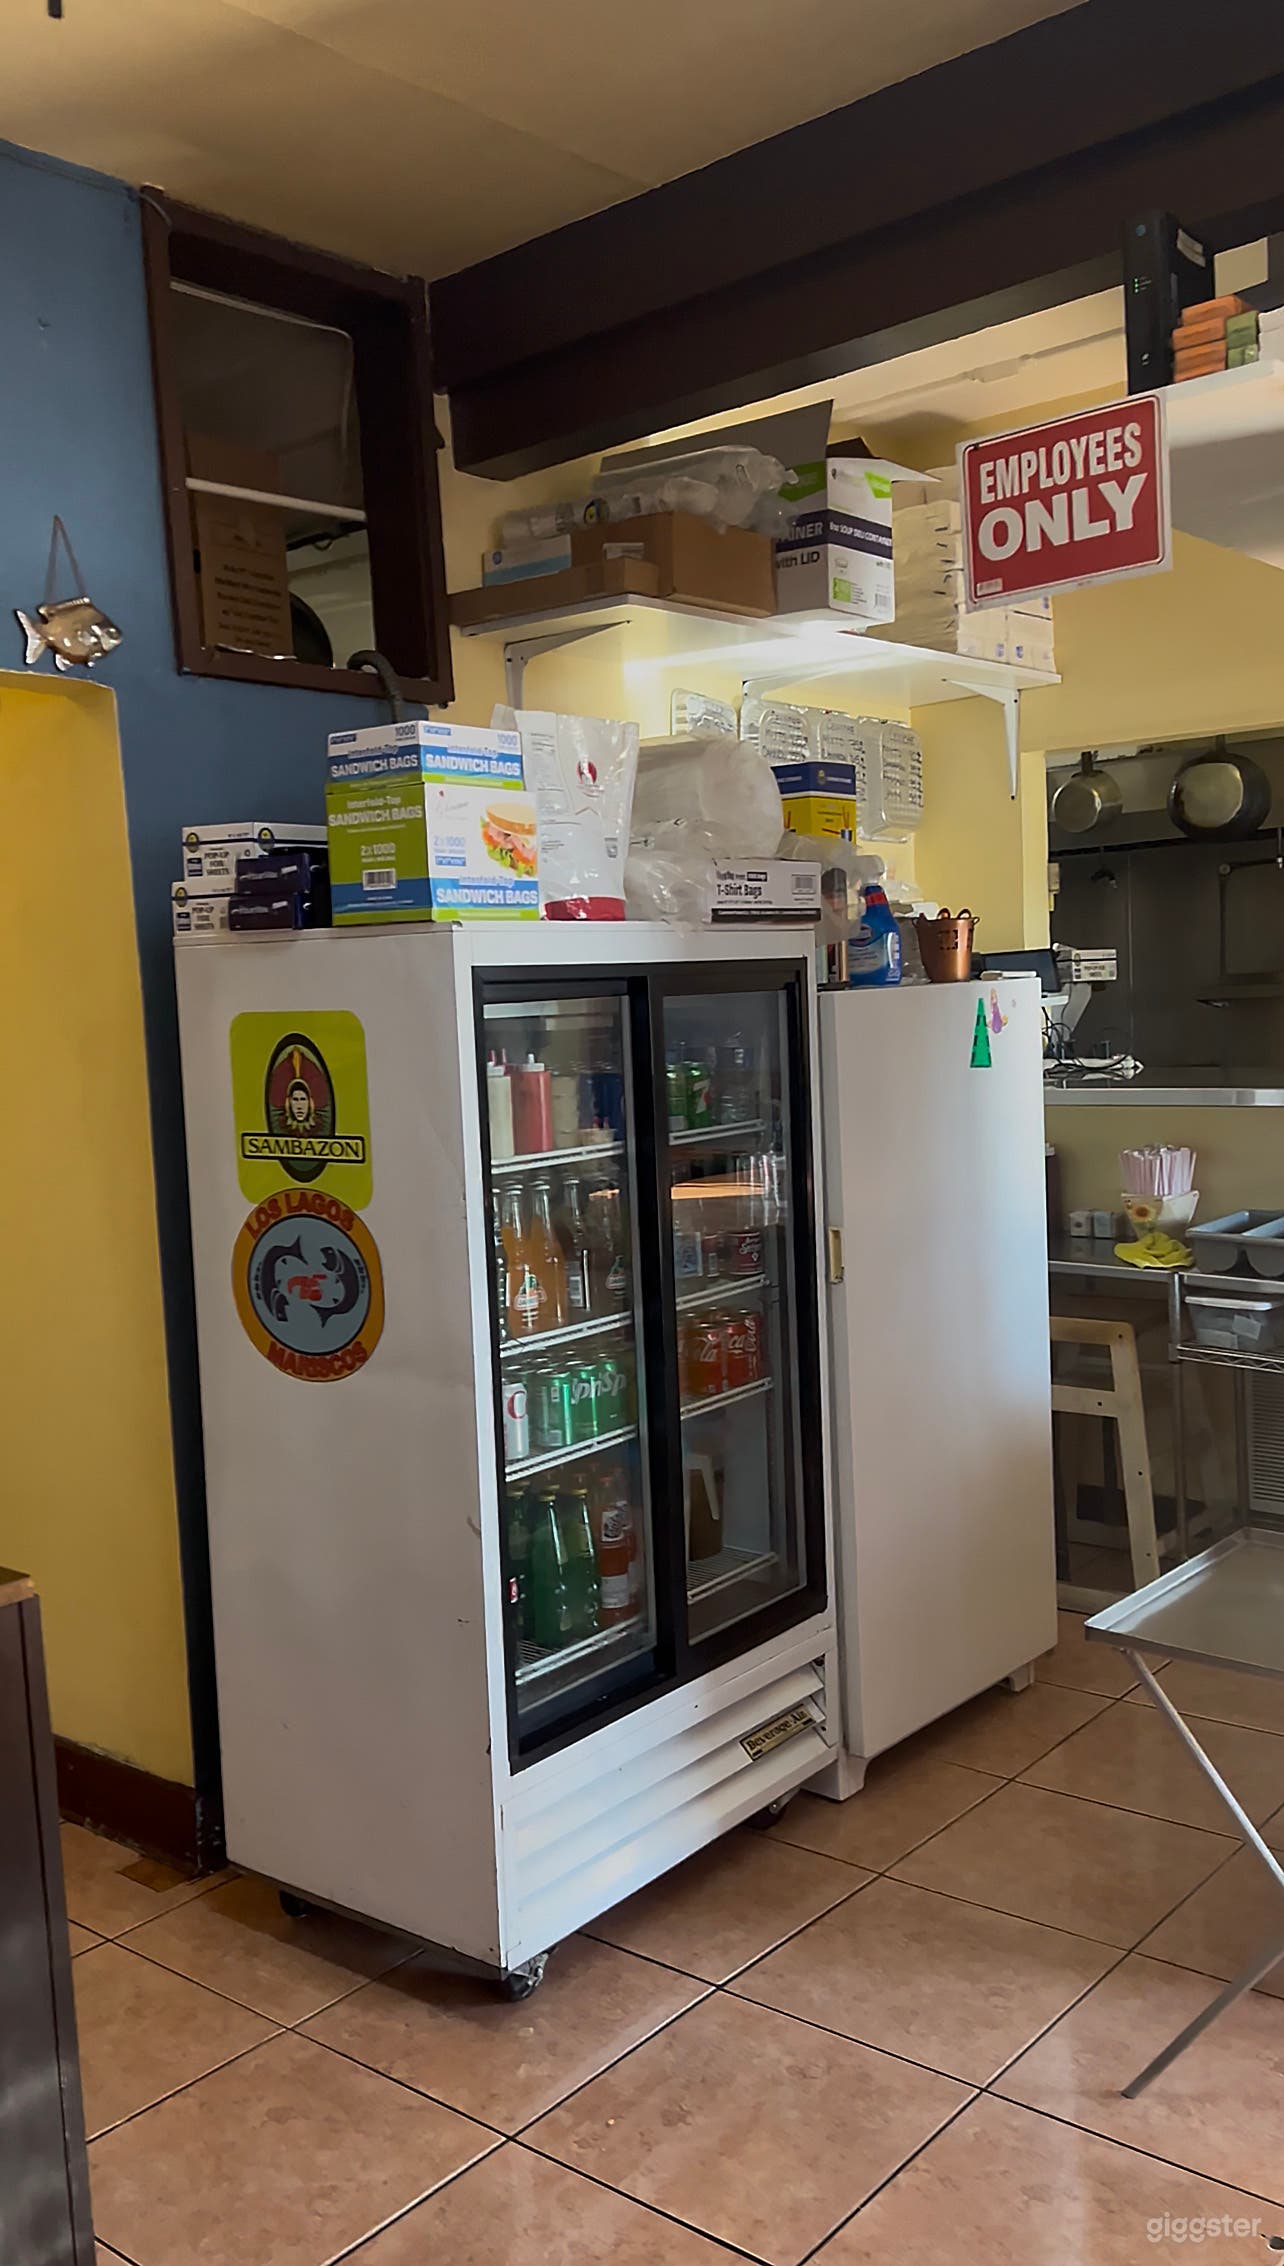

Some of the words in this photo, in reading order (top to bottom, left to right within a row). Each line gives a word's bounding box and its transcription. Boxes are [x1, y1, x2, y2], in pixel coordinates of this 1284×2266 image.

[979, 422, 1142, 504] EMPLOYEES
[978, 472, 1148, 562] ONLY
[800, 551, 820, 565] LID
[395, 725, 416, 737] 1000
[497, 733, 518, 746] 1000
[331, 758, 389, 777] SANDWICH
[389, 754, 418, 769] BAGS
[425, 753, 488, 773] SANDWICH
[490, 759, 521, 776] BAGS
[328, 808, 390, 827] SANDWICH
[392, 805, 422, 820] BAGS
[436, 887, 505, 904] SANDWICH
[505, 890, 538, 905] BAGS
[717, 883, 743, 896] T-Shirt
[744, 884, 763, 899] Bags
[248, 1137, 360, 1158] SAMBAZON
[244, 1197, 283, 1241] LOS
[284, 1191, 355, 1232] LAGOS
[267, 1340, 369, 1379] MARISCOS
[746, 1719, 794, 1751] Beverage
